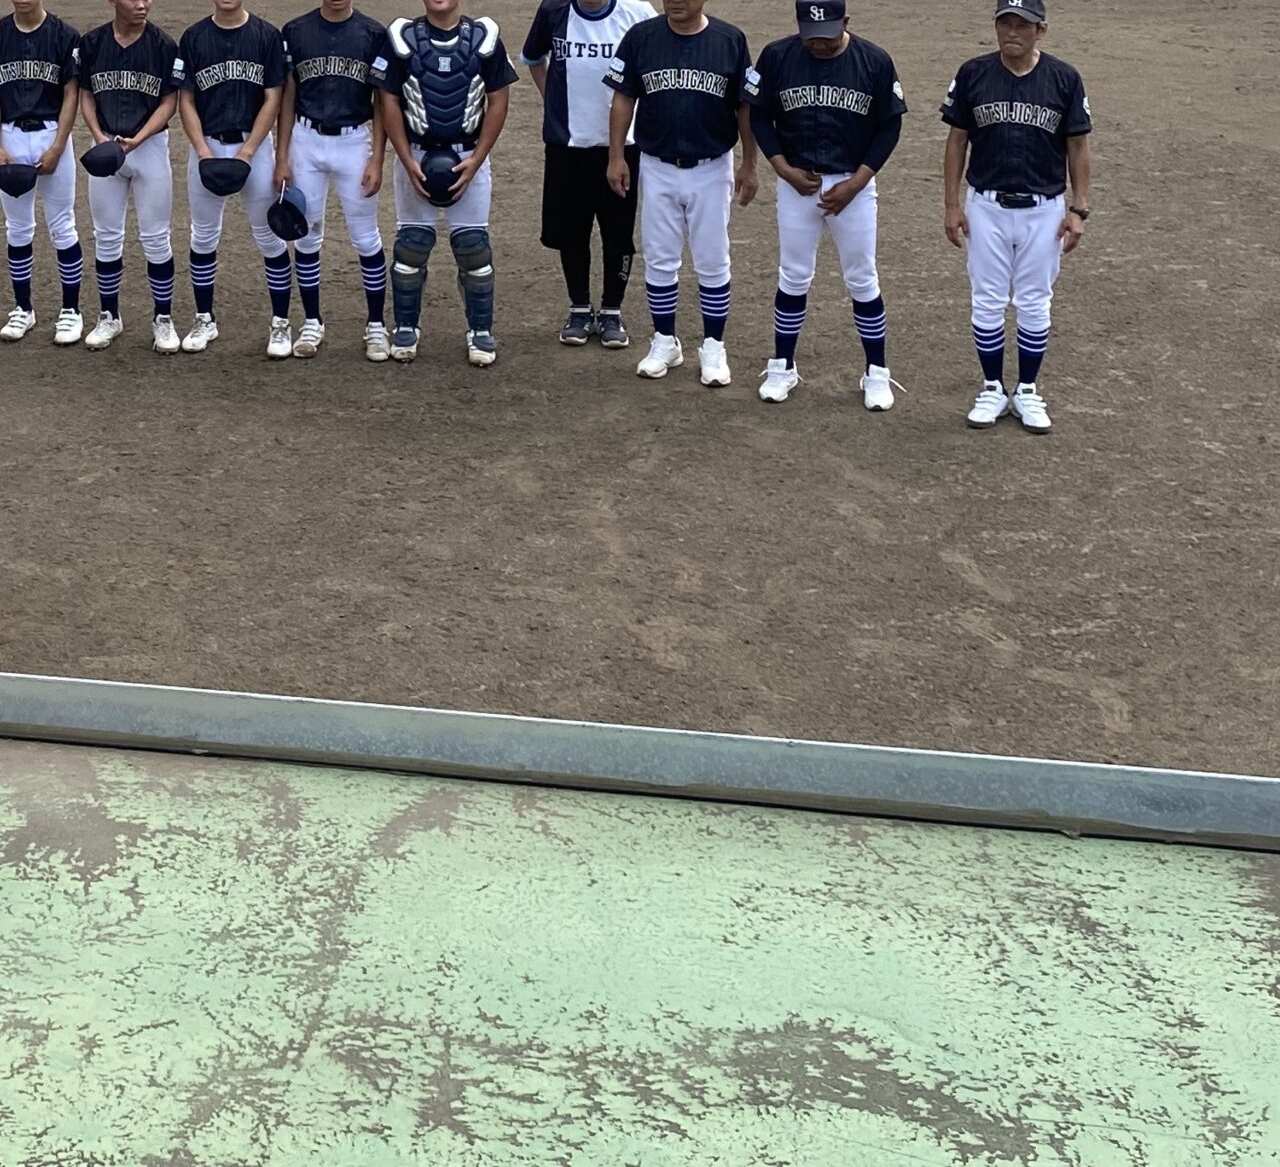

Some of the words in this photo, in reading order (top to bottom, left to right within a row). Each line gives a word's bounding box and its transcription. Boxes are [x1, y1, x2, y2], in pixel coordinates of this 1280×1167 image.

[810, 5, 826, 21] SH
[641, 68, 728, 98] HITSUJIGAOKA
[779, 85, 873, 115] HITSUJIGAOKA
[973, 102, 1062, 134] HITSUJIGAOKA
